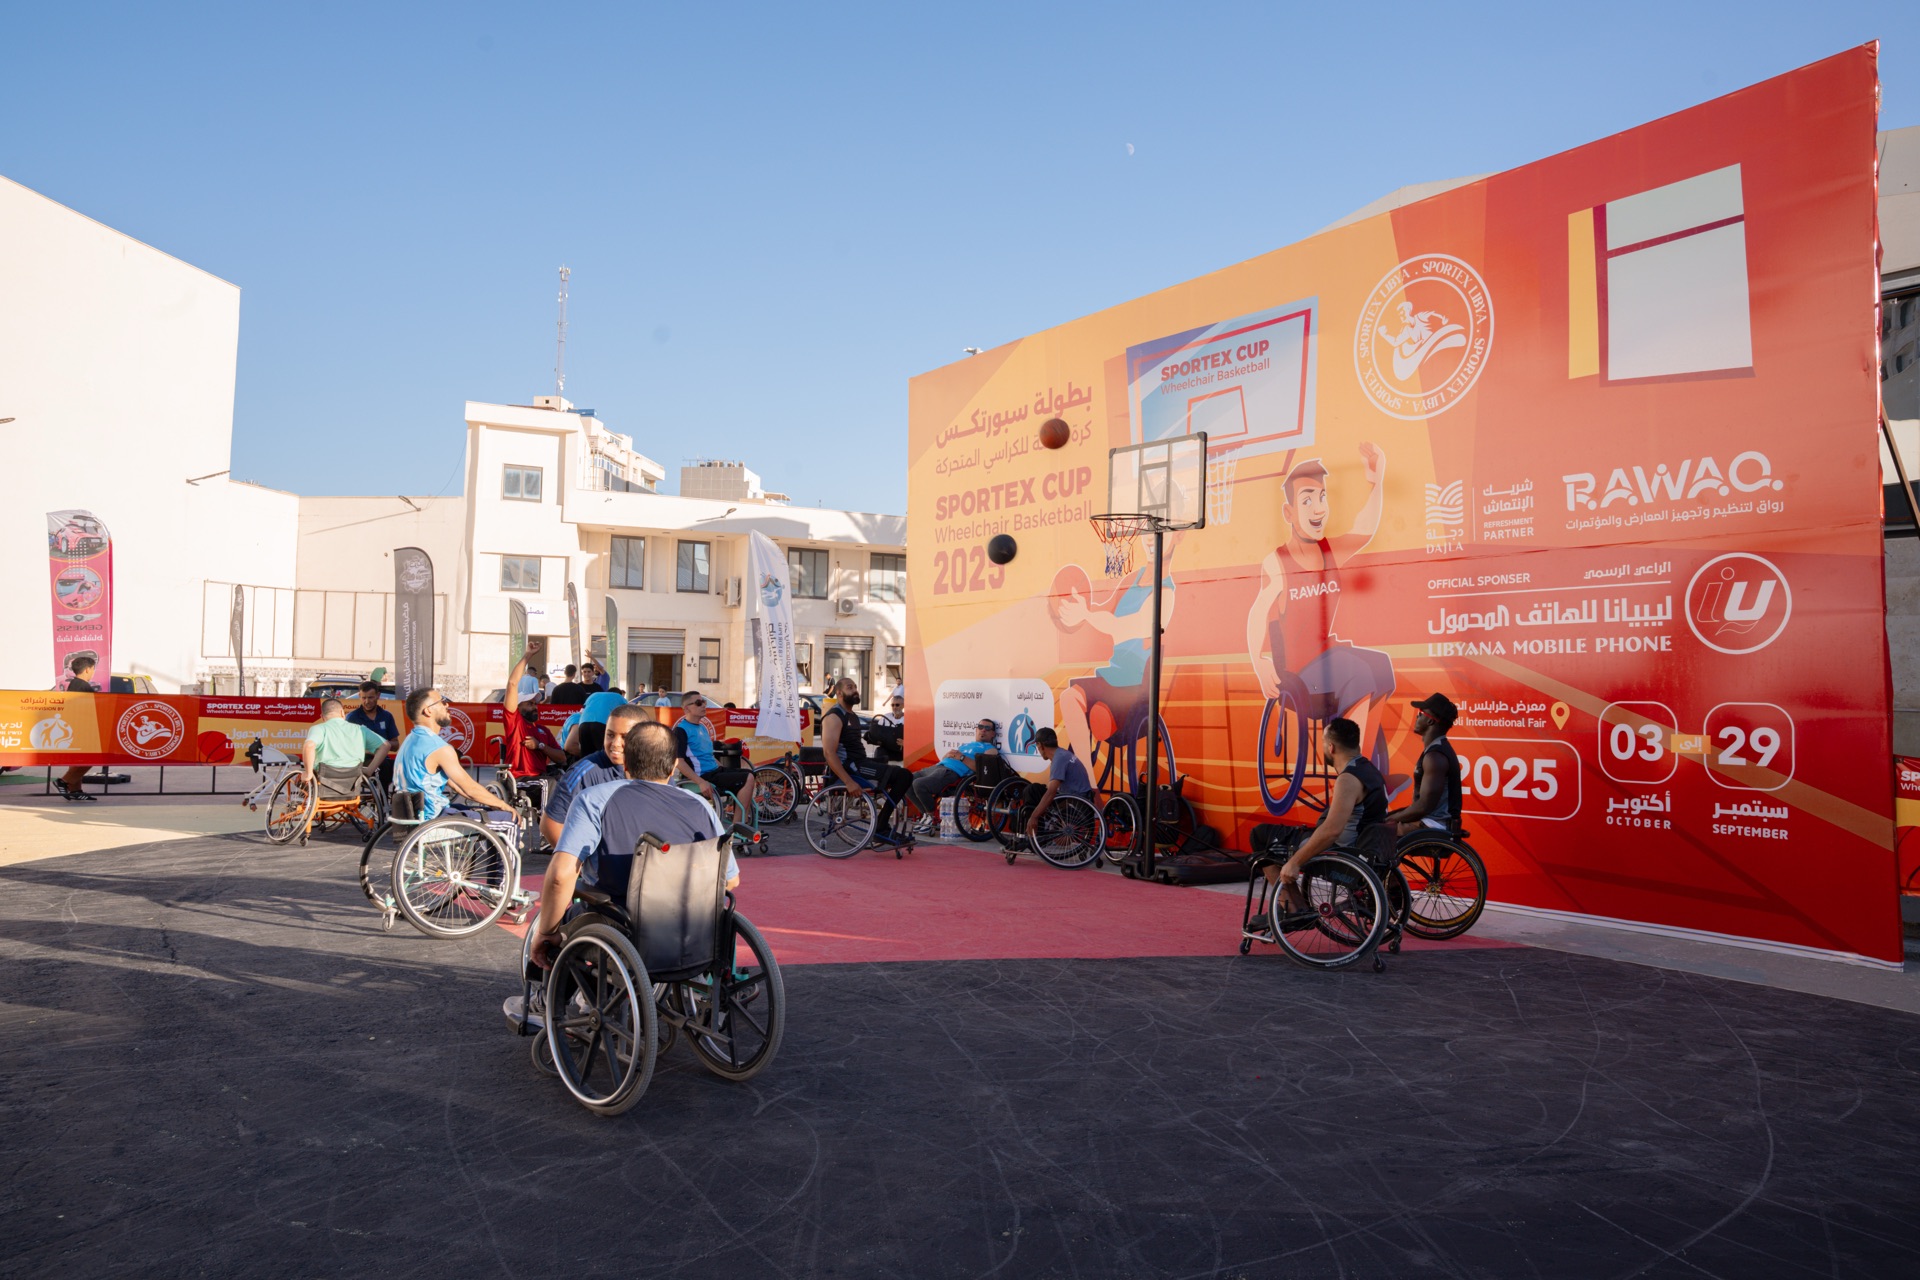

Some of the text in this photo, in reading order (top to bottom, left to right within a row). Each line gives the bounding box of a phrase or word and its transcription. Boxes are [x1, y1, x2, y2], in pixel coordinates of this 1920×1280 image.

[1422, 261, 1487, 325] SPORTEX LIBYA
[1359, 269, 1410, 358] SPORTEX LIBYA
[1161, 340, 1270, 382] SPORTEX CUP
[1412, 337, 1485, 412] SPORTEX LIBYA
[1160, 358, 1270, 395] Wheelchair Basketball
[1363, 368, 1403, 410] SPORTEX
[1033, 382, 1092, 419] بطولة
[936, 404, 1028, 449] سبورتكس
[1071, 420, 1092, 446] كرة
[935, 448, 980, 477] المتحركة
[983, 435, 1029, 474] للكراسي
[935, 466, 1092, 521] SPORTEX CUP
[1482, 478, 1533, 497] شريك
[935, 500, 1092, 544] Wheelchair Basketball
[1483, 517, 1534, 529] REFRESHMENT
[1566, 499, 1784, 531] رواق لتنظيم وتجهيز المعارض والمؤتمرات
[1426, 528, 1464, 541] دجلة
[1484, 527, 1534, 541] PARTNER
[1426, 542, 1464, 555] DAJLA
[1427, 573, 1531, 590] OFFICIAL SPONSER
[1583, 561, 1672, 579] الراعي الرسمي
[1427, 595, 1672, 635] ليبيانا للهاتف المحمول
[1427, 635, 1672, 657] LIBYANA MOBILE PHONE
[1468, 700, 1509, 713] طرابلس
[1510, 700, 1546, 714] معرض
[1466, 717, 1525, 727] International
[1527, 718, 1547, 728] Fair
[1610, 723, 1664, 761] 03
[1679, 737, 1702, 752] إلى
[1718, 726, 1781, 767] 29
[1456, 755, 1558, 801] 2025
[1606, 790, 1671, 815] أكتوبر
[1712, 800, 1789, 823] سبتمبر
[1606, 816, 1671, 830] OCTOBER
[1712, 823, 1789, 840] SEPTEMBER
